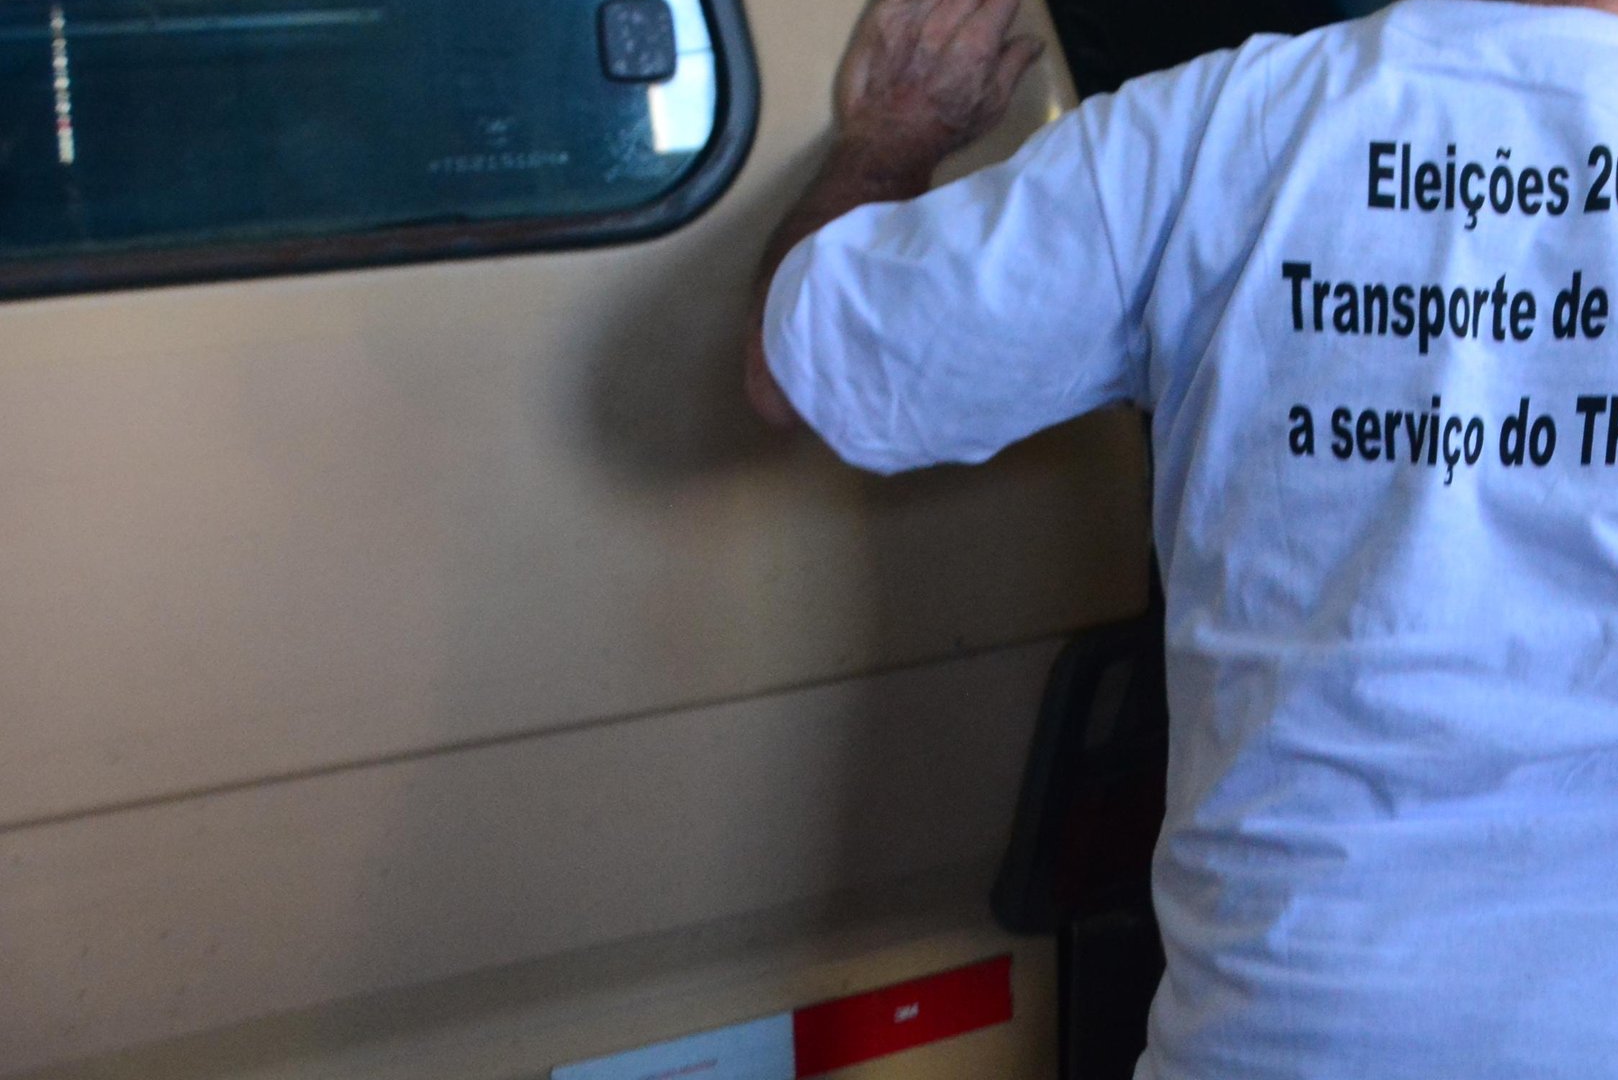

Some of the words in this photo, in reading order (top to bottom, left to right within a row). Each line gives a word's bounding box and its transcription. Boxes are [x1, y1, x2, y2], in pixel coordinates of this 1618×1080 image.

[1367, 140, 1570, 231] Eleições
[1281, 261, 1537, 355] Transporte
[1551, 271, 1610, 340] de
[1288, 401, 1315, 458] a
[1330, 395, 1485, 486] serviço
[1499, 397, 1558, 467] do
